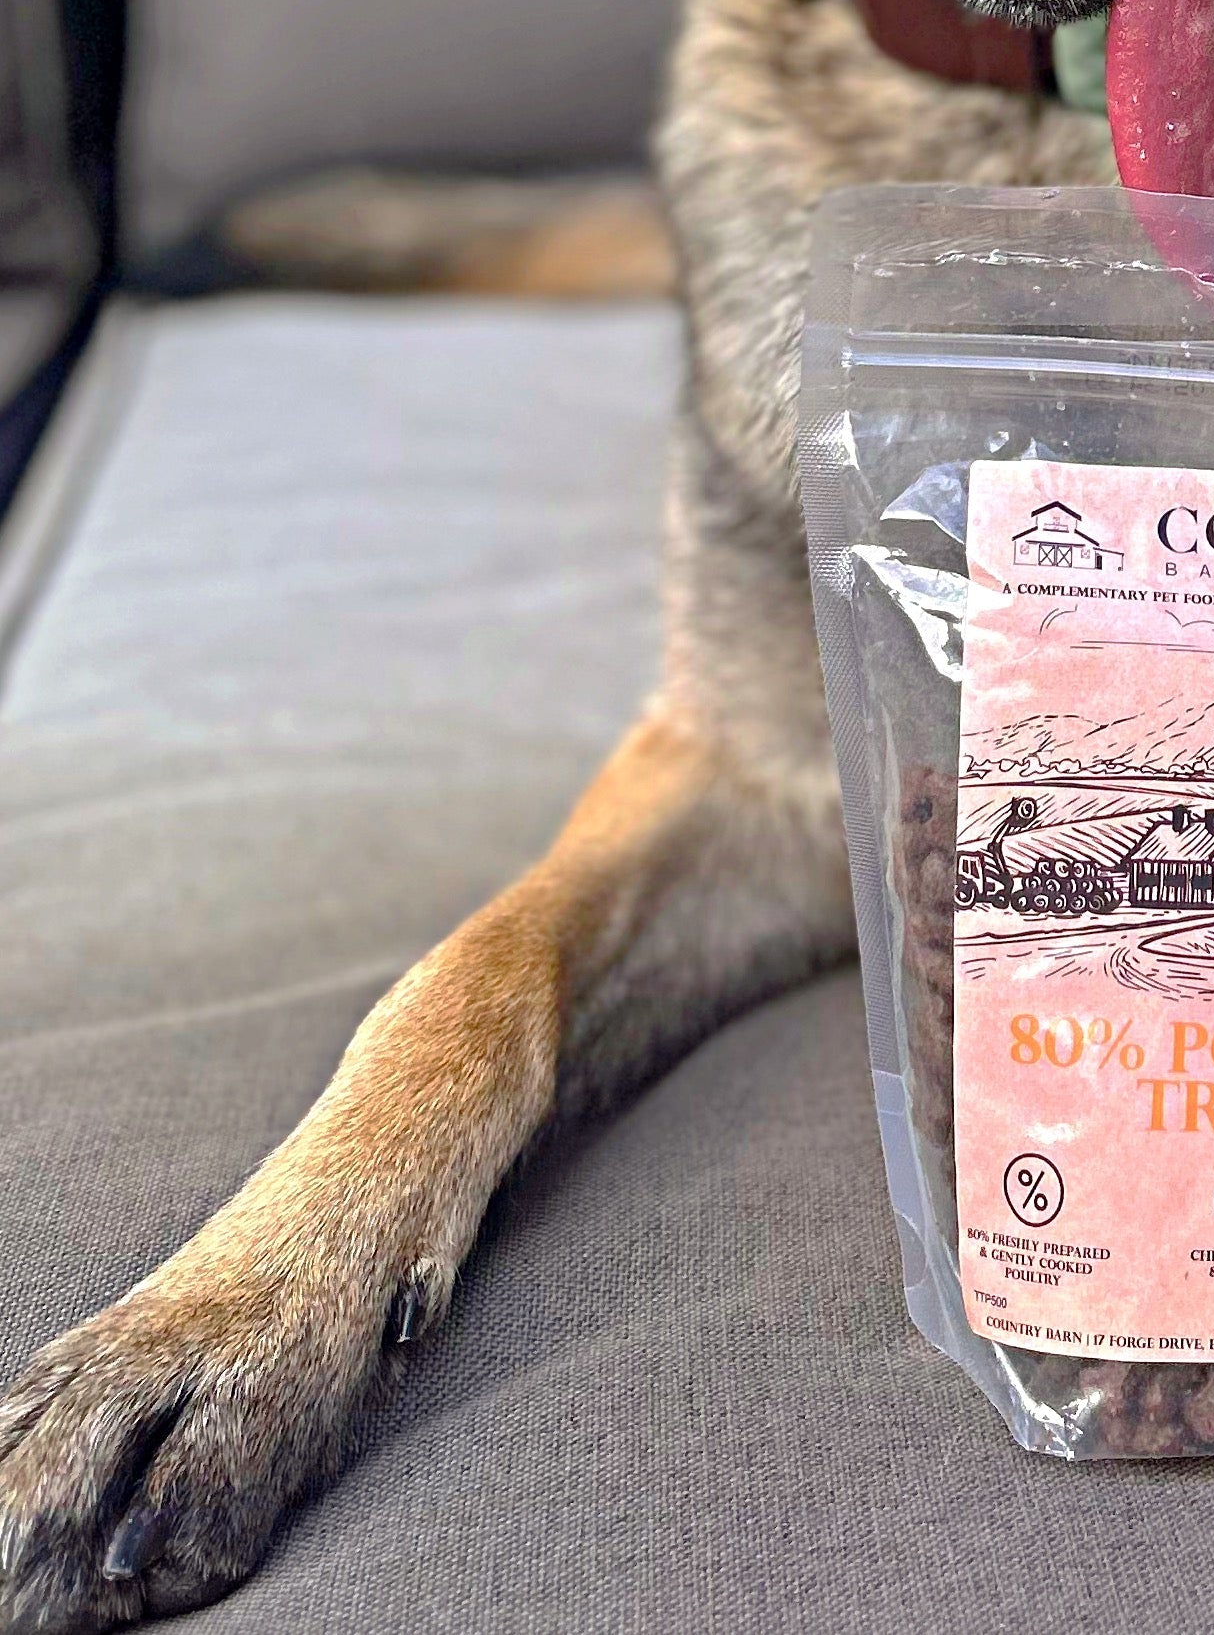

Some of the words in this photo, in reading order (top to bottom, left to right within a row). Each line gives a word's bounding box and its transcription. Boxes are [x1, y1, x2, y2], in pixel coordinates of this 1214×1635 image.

[1002, 582, 1012, 595] A
[1017, 582, 1148, 602] COMPLEMENTARY
[1153, 590, 1179, 603] PET
[1009, 1012, 1146, 1071] 80%
[966, 1227, 990, 1243] 80%
[992, 1232, 1040, 1253] FRESHLY
[1043, 1242, 1111, 1261] PREPARED
[979, 1246, 988, 1258] &
[991, 1248, 1036, 1267] GENTLY
[1039, 1257, 1093, 1275] COOKED
[1004, 1266, 1062, 1287] POULTRY
[973, 1289, 1008, 1309] TTP500
[985, 1315, 1042, 1338] COUNTRY
[1046, 1327, 1083, 1344] BARN
[1093, 1334, 1105, 1346] 17
[1109, 1335, 1155, 1349] FORGE
[1158, 1337, 1206, 1351] DRIVE,
